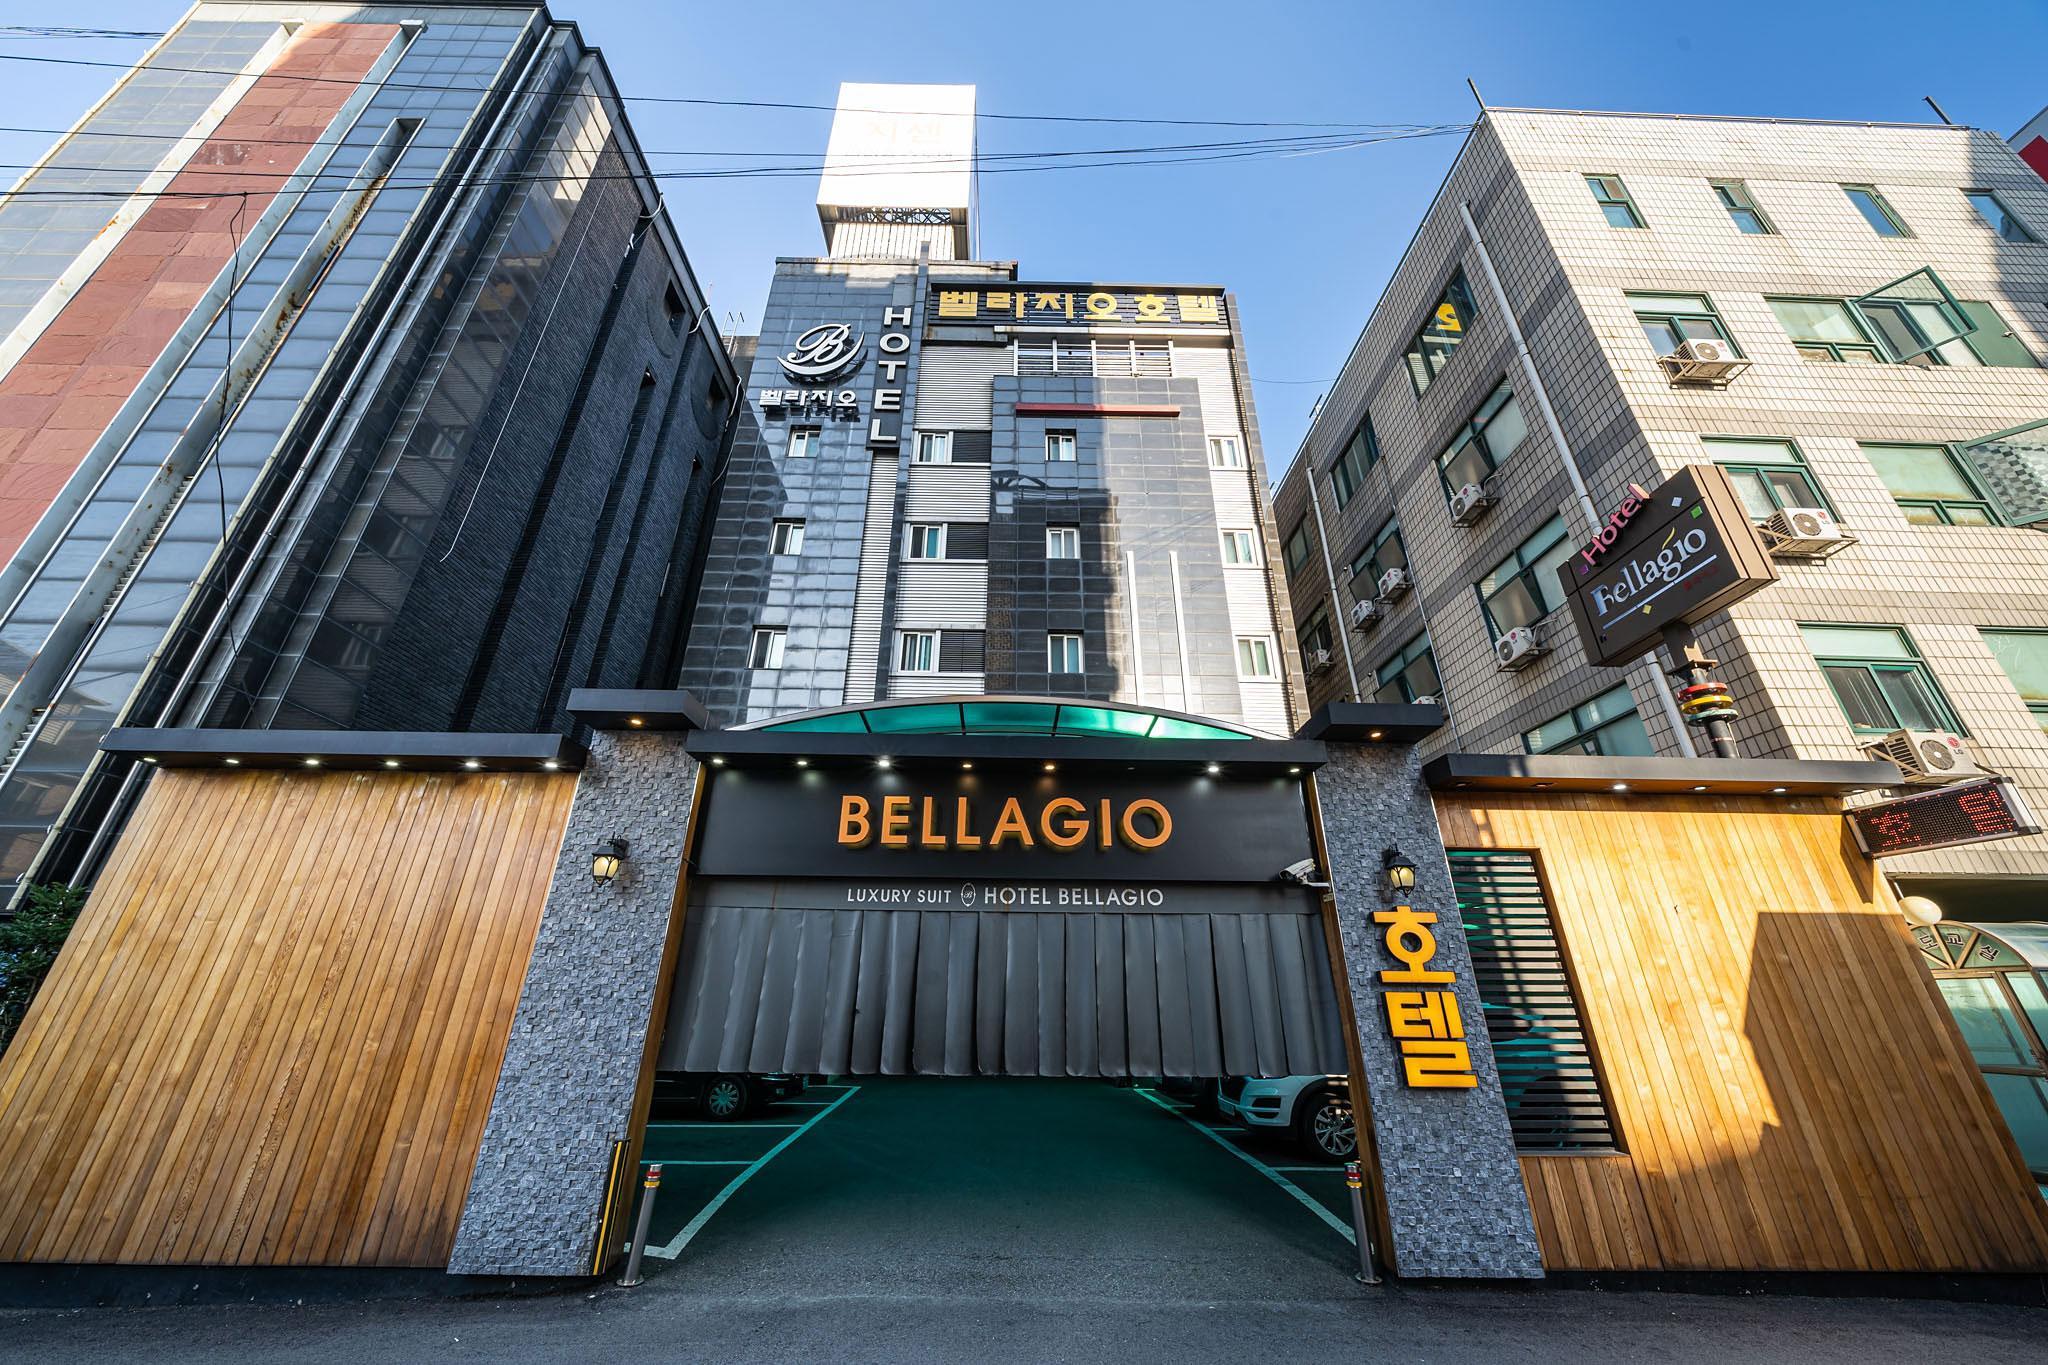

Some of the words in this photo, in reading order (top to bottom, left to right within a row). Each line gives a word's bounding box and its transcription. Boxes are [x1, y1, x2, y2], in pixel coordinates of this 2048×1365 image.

[758, 389, 857, 407] 벨라지오
[870, 307, 912, 442] HOTEL
[1581, 482, 1651, 566] Hotel
[837, 794, 1174, 848] BELLAGIO
[847, 888, 912, 903] LUXURY
[916, 889, 952, 904] SUIT
[984, 887, 1051, 905] HOTEL
[1058, 887, 1164, 906] BELLAGIO
[1372, 905, 1479, 1089] 호텔
